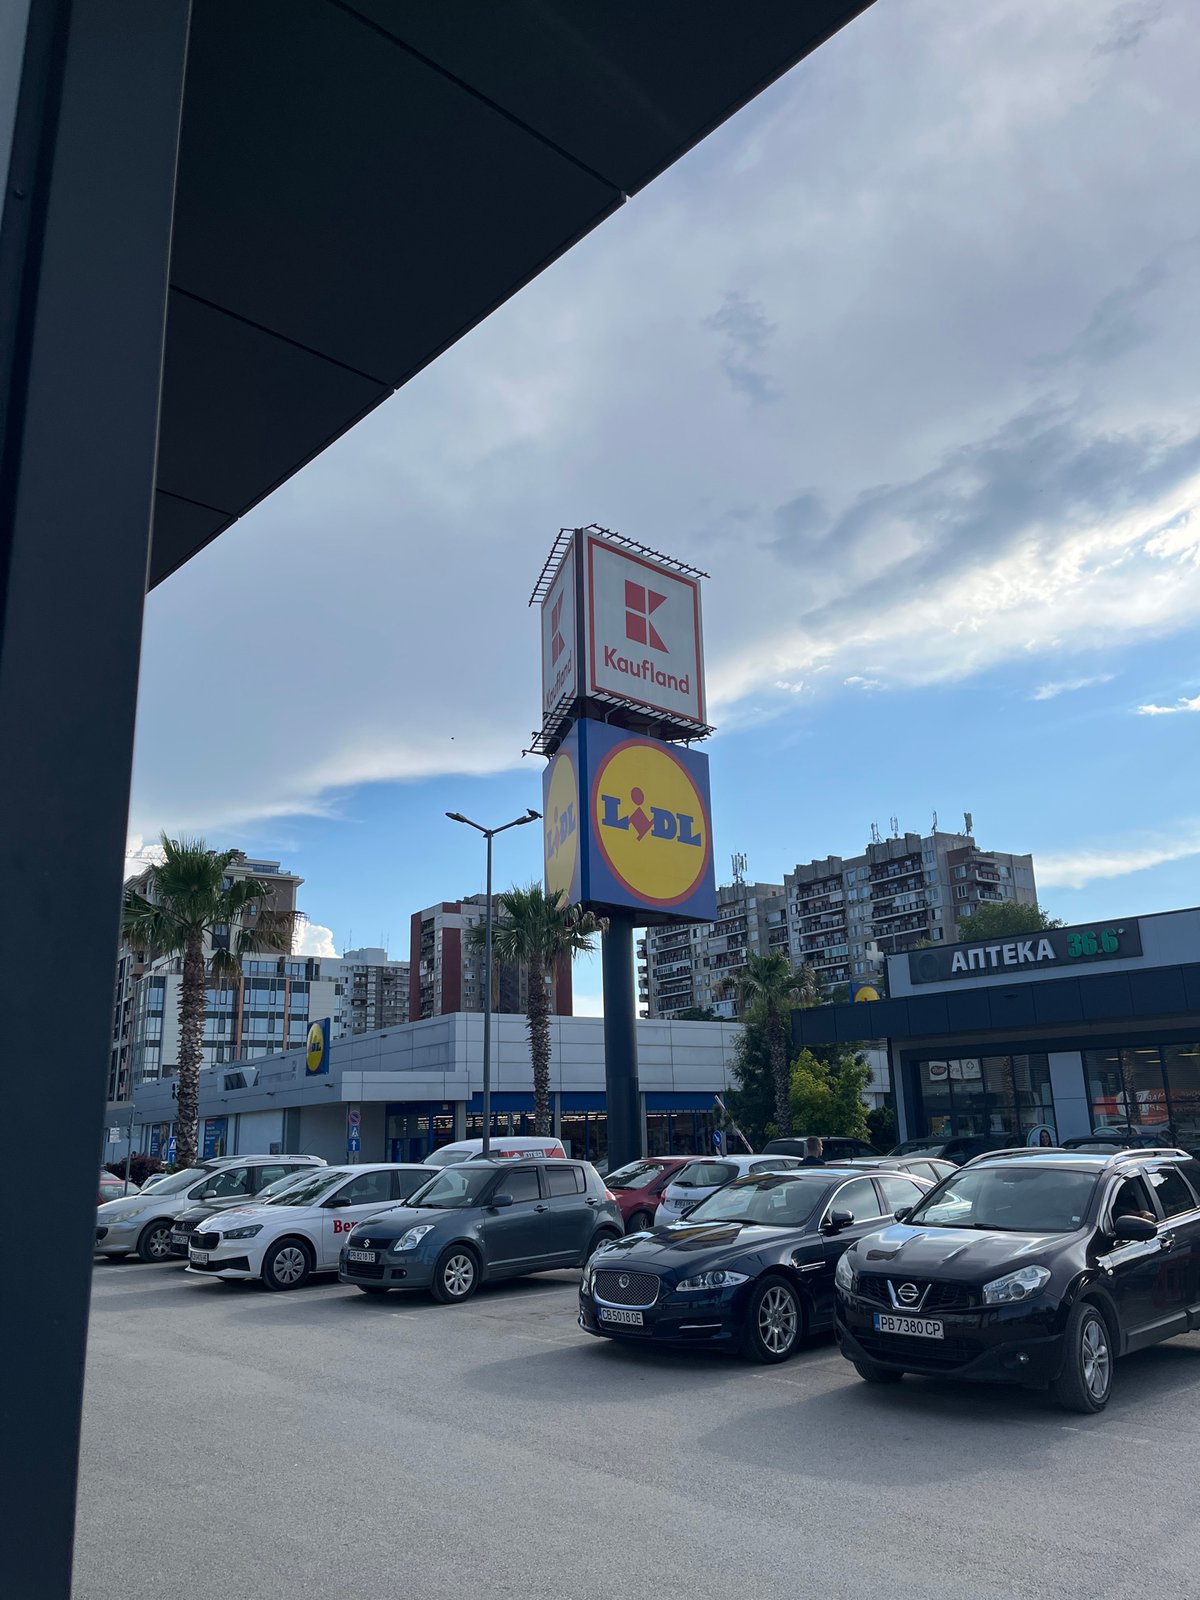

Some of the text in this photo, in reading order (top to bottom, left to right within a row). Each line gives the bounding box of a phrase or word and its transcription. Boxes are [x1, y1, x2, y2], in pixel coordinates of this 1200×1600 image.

[545, 649, 573, 709] Kaufland
[604, 645, 690, 695] Kaufland
[951, 938, 1057, 973] АПТЕКА
[613, 1311, 631, 1322] 5018
[881, 1316, 941, 1336] PB 7380 CP
